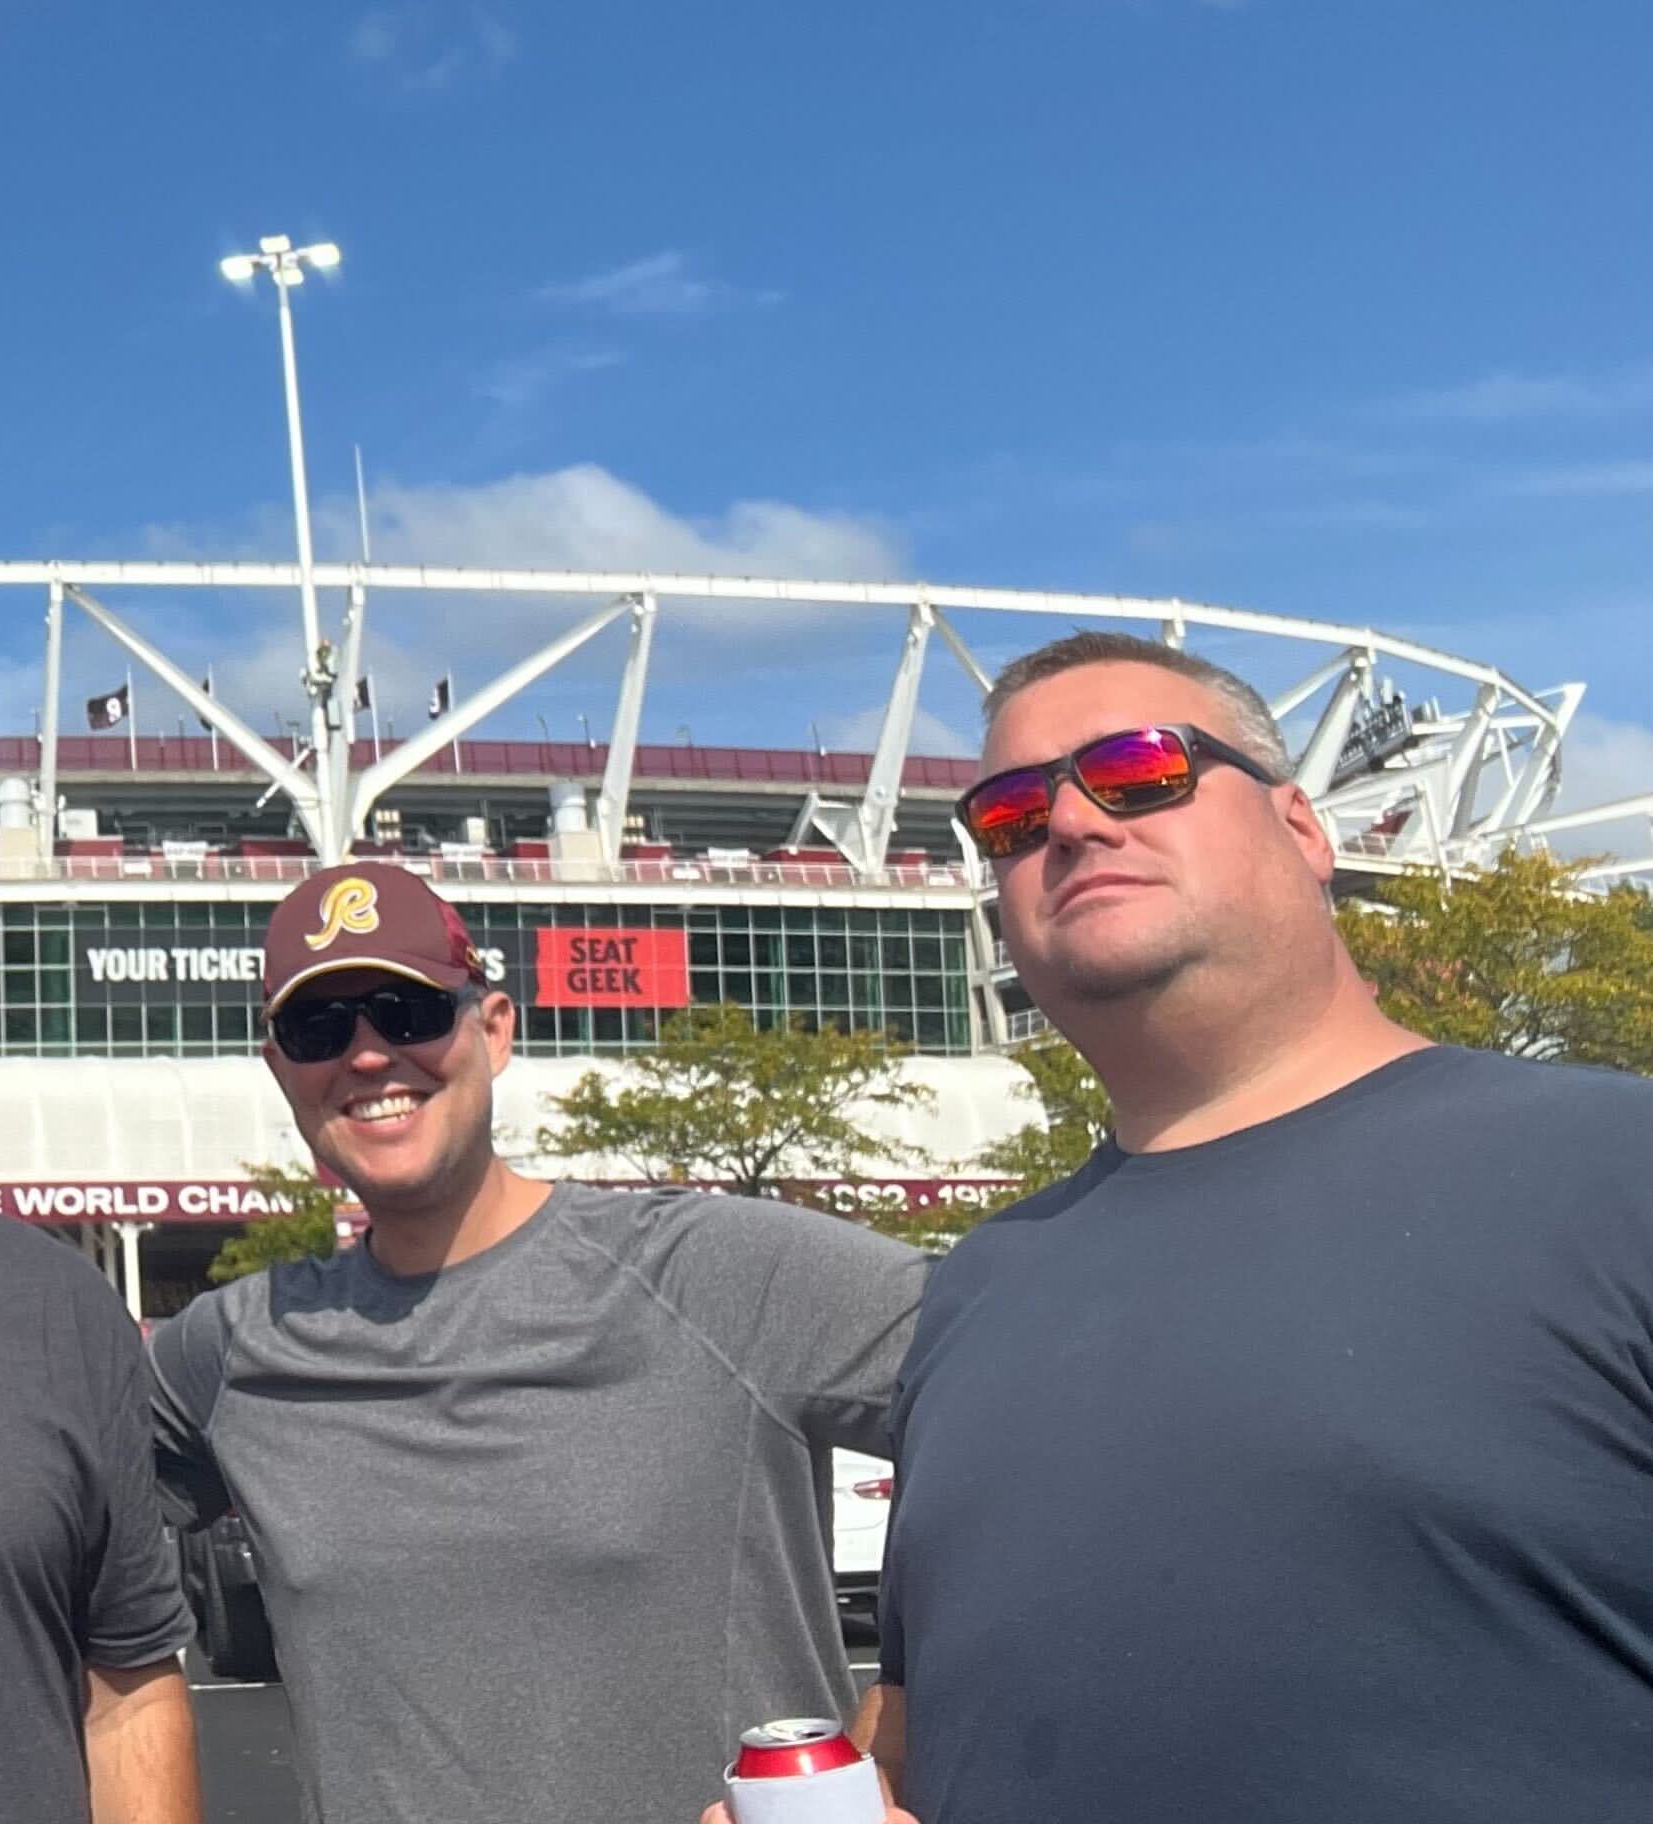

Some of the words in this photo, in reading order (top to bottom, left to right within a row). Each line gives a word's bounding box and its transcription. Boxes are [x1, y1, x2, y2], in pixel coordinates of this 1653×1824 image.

[86, 947, 169, 982] YOUR
[570, 937, 639, 965] SEAT
[566, 967, 643, 995] GEEK
[12, 1187, 170, 1217] WORLD
